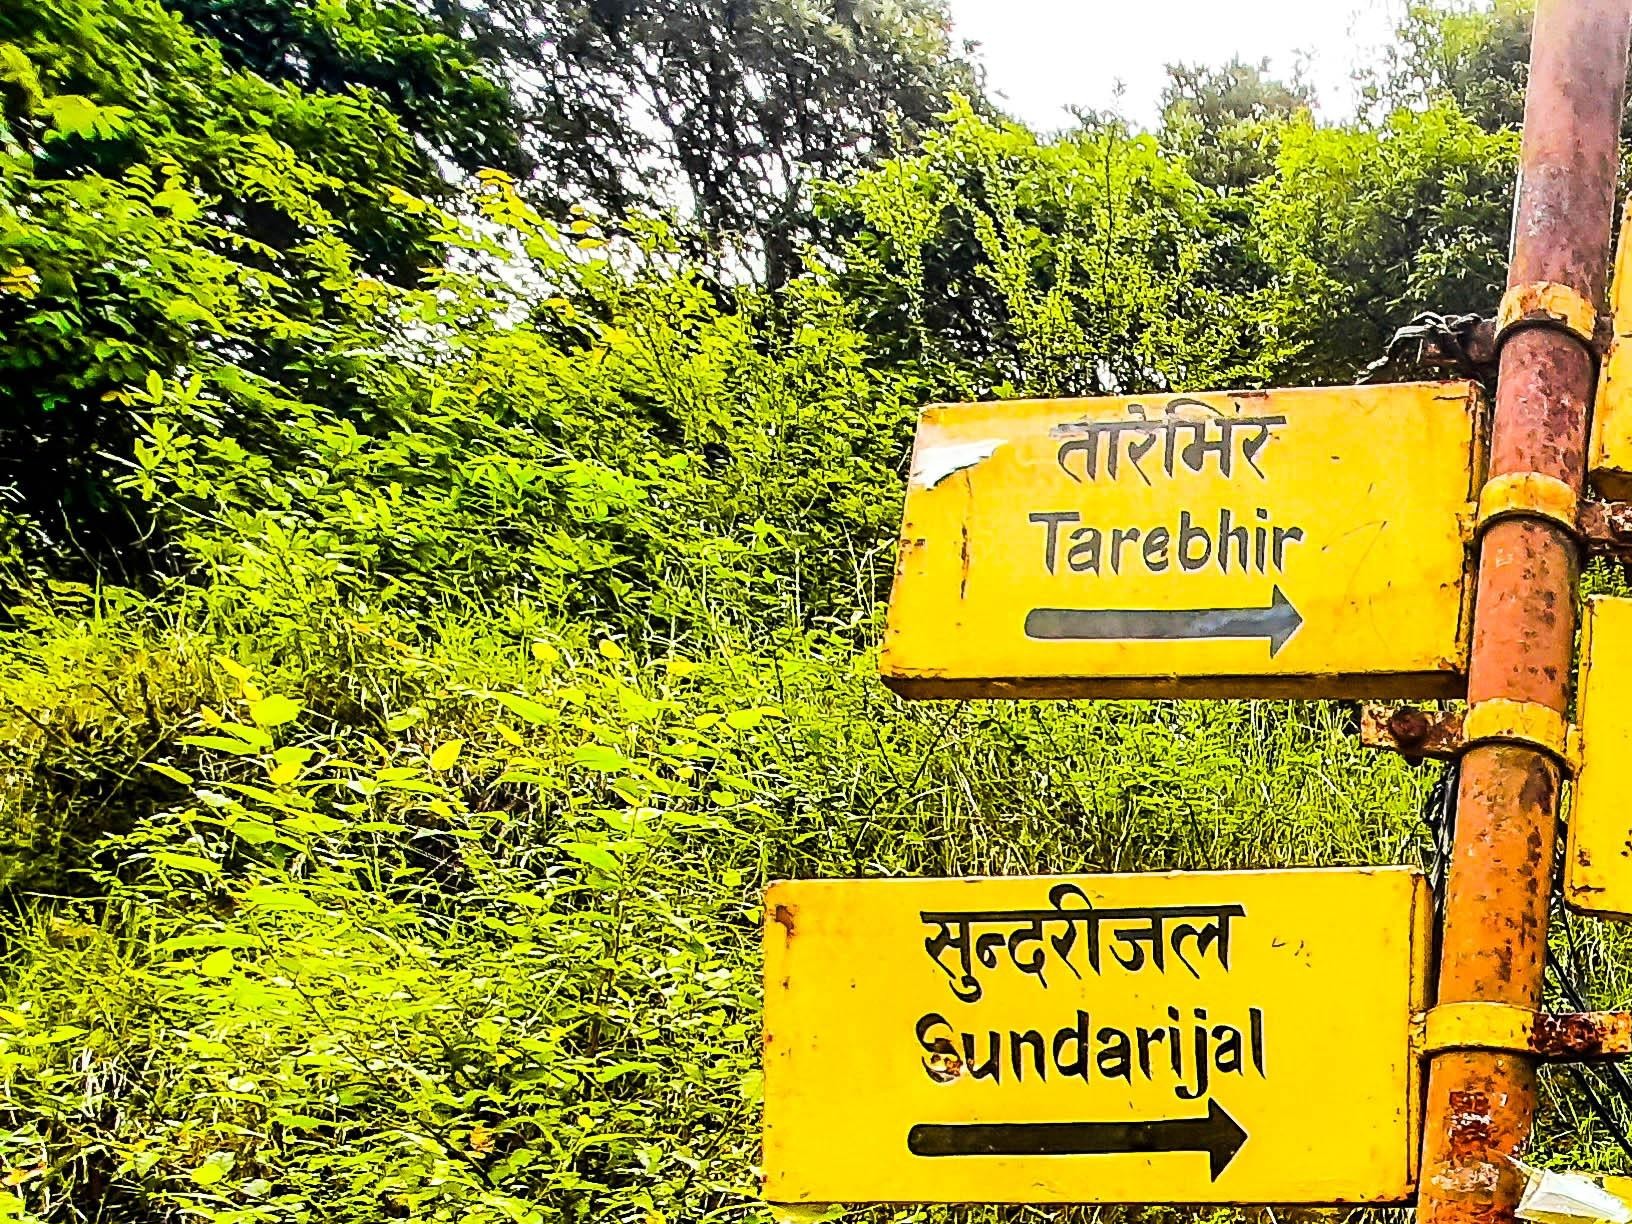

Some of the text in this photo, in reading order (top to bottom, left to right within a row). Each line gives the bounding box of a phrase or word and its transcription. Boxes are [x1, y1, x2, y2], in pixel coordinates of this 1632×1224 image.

[1029, 508, 1304, 576] Tarebhir
[921, 884, 1245, 1002] सुन्दरीजल
[916, 1007, 1266, 1100] Sundarijal
